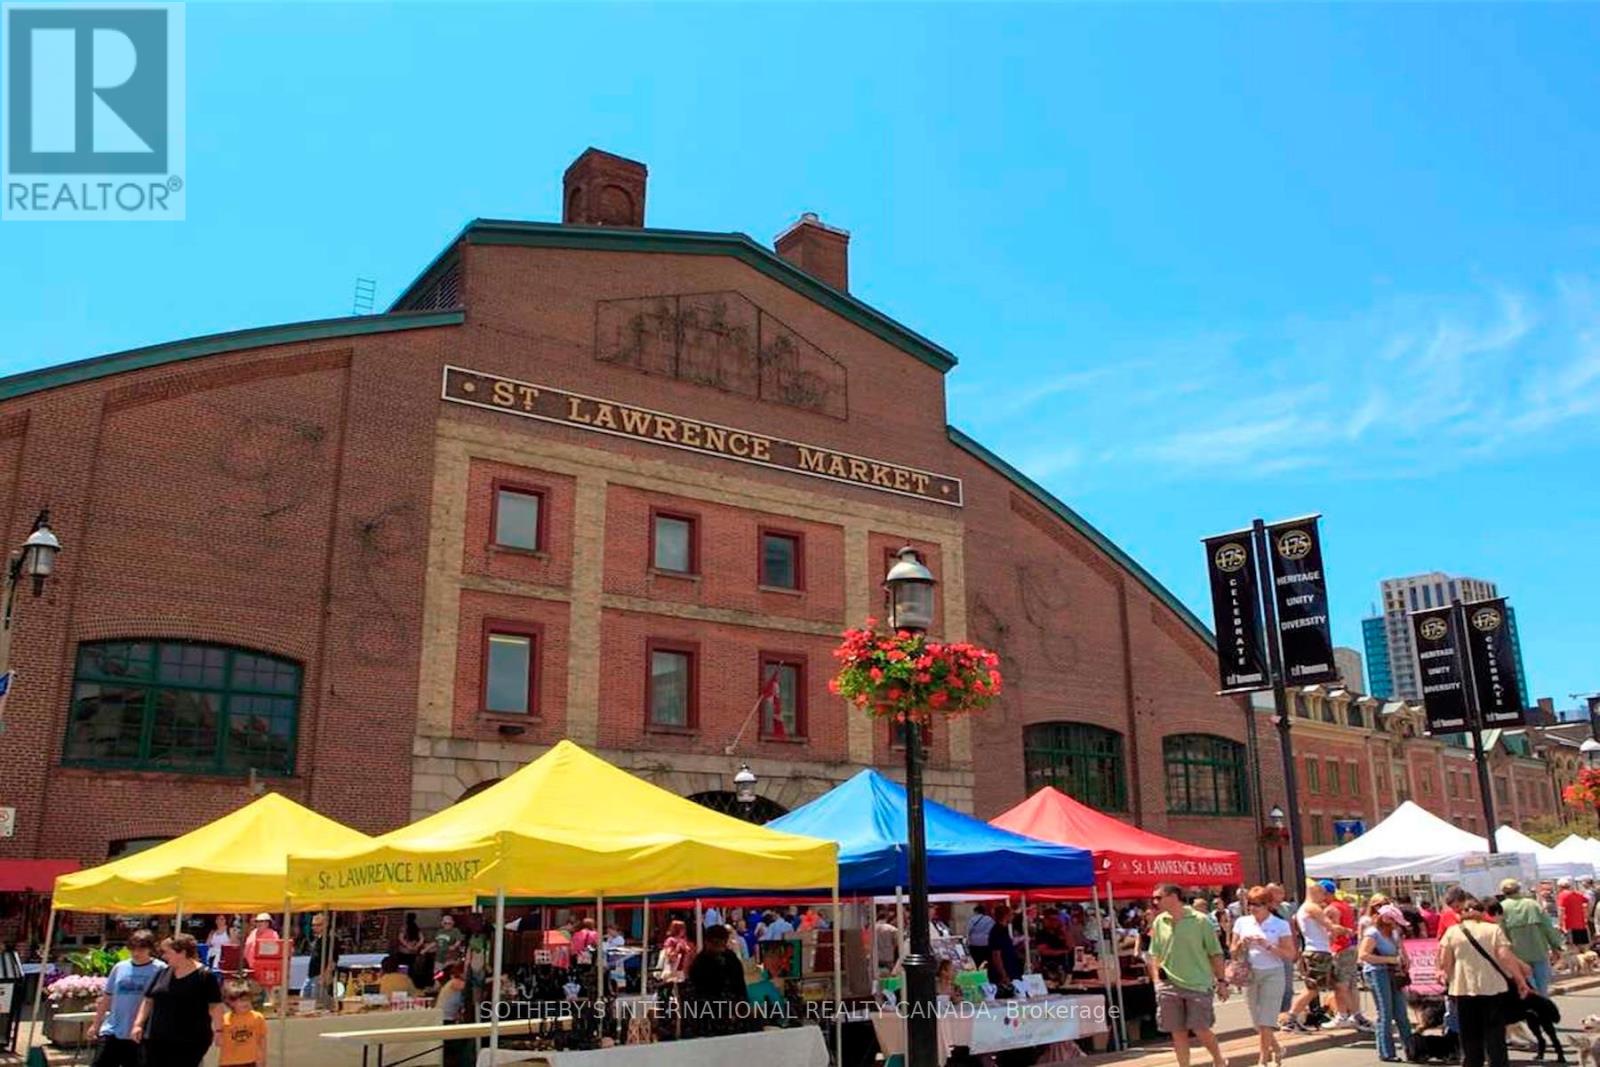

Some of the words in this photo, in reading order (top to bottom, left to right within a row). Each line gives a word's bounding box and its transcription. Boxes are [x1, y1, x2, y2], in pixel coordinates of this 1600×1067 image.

[568, 397, 770, 462] LAWRENCE
[798, 447, 929, 494] MARKET
[1276, 570, 1321, 586] HERITAGE
[1286, 594, 1315, 607] UNITY
[1229, 578, 1246, 666] CELEBRATE
[1281, 615, 1327, 631] DIVERSITY
[338, 861, 413, 888] LAWRENCE
[1147, 859, 1198, 876] LAWRENCE
[1199, 862, 1233, 876] MARKET
